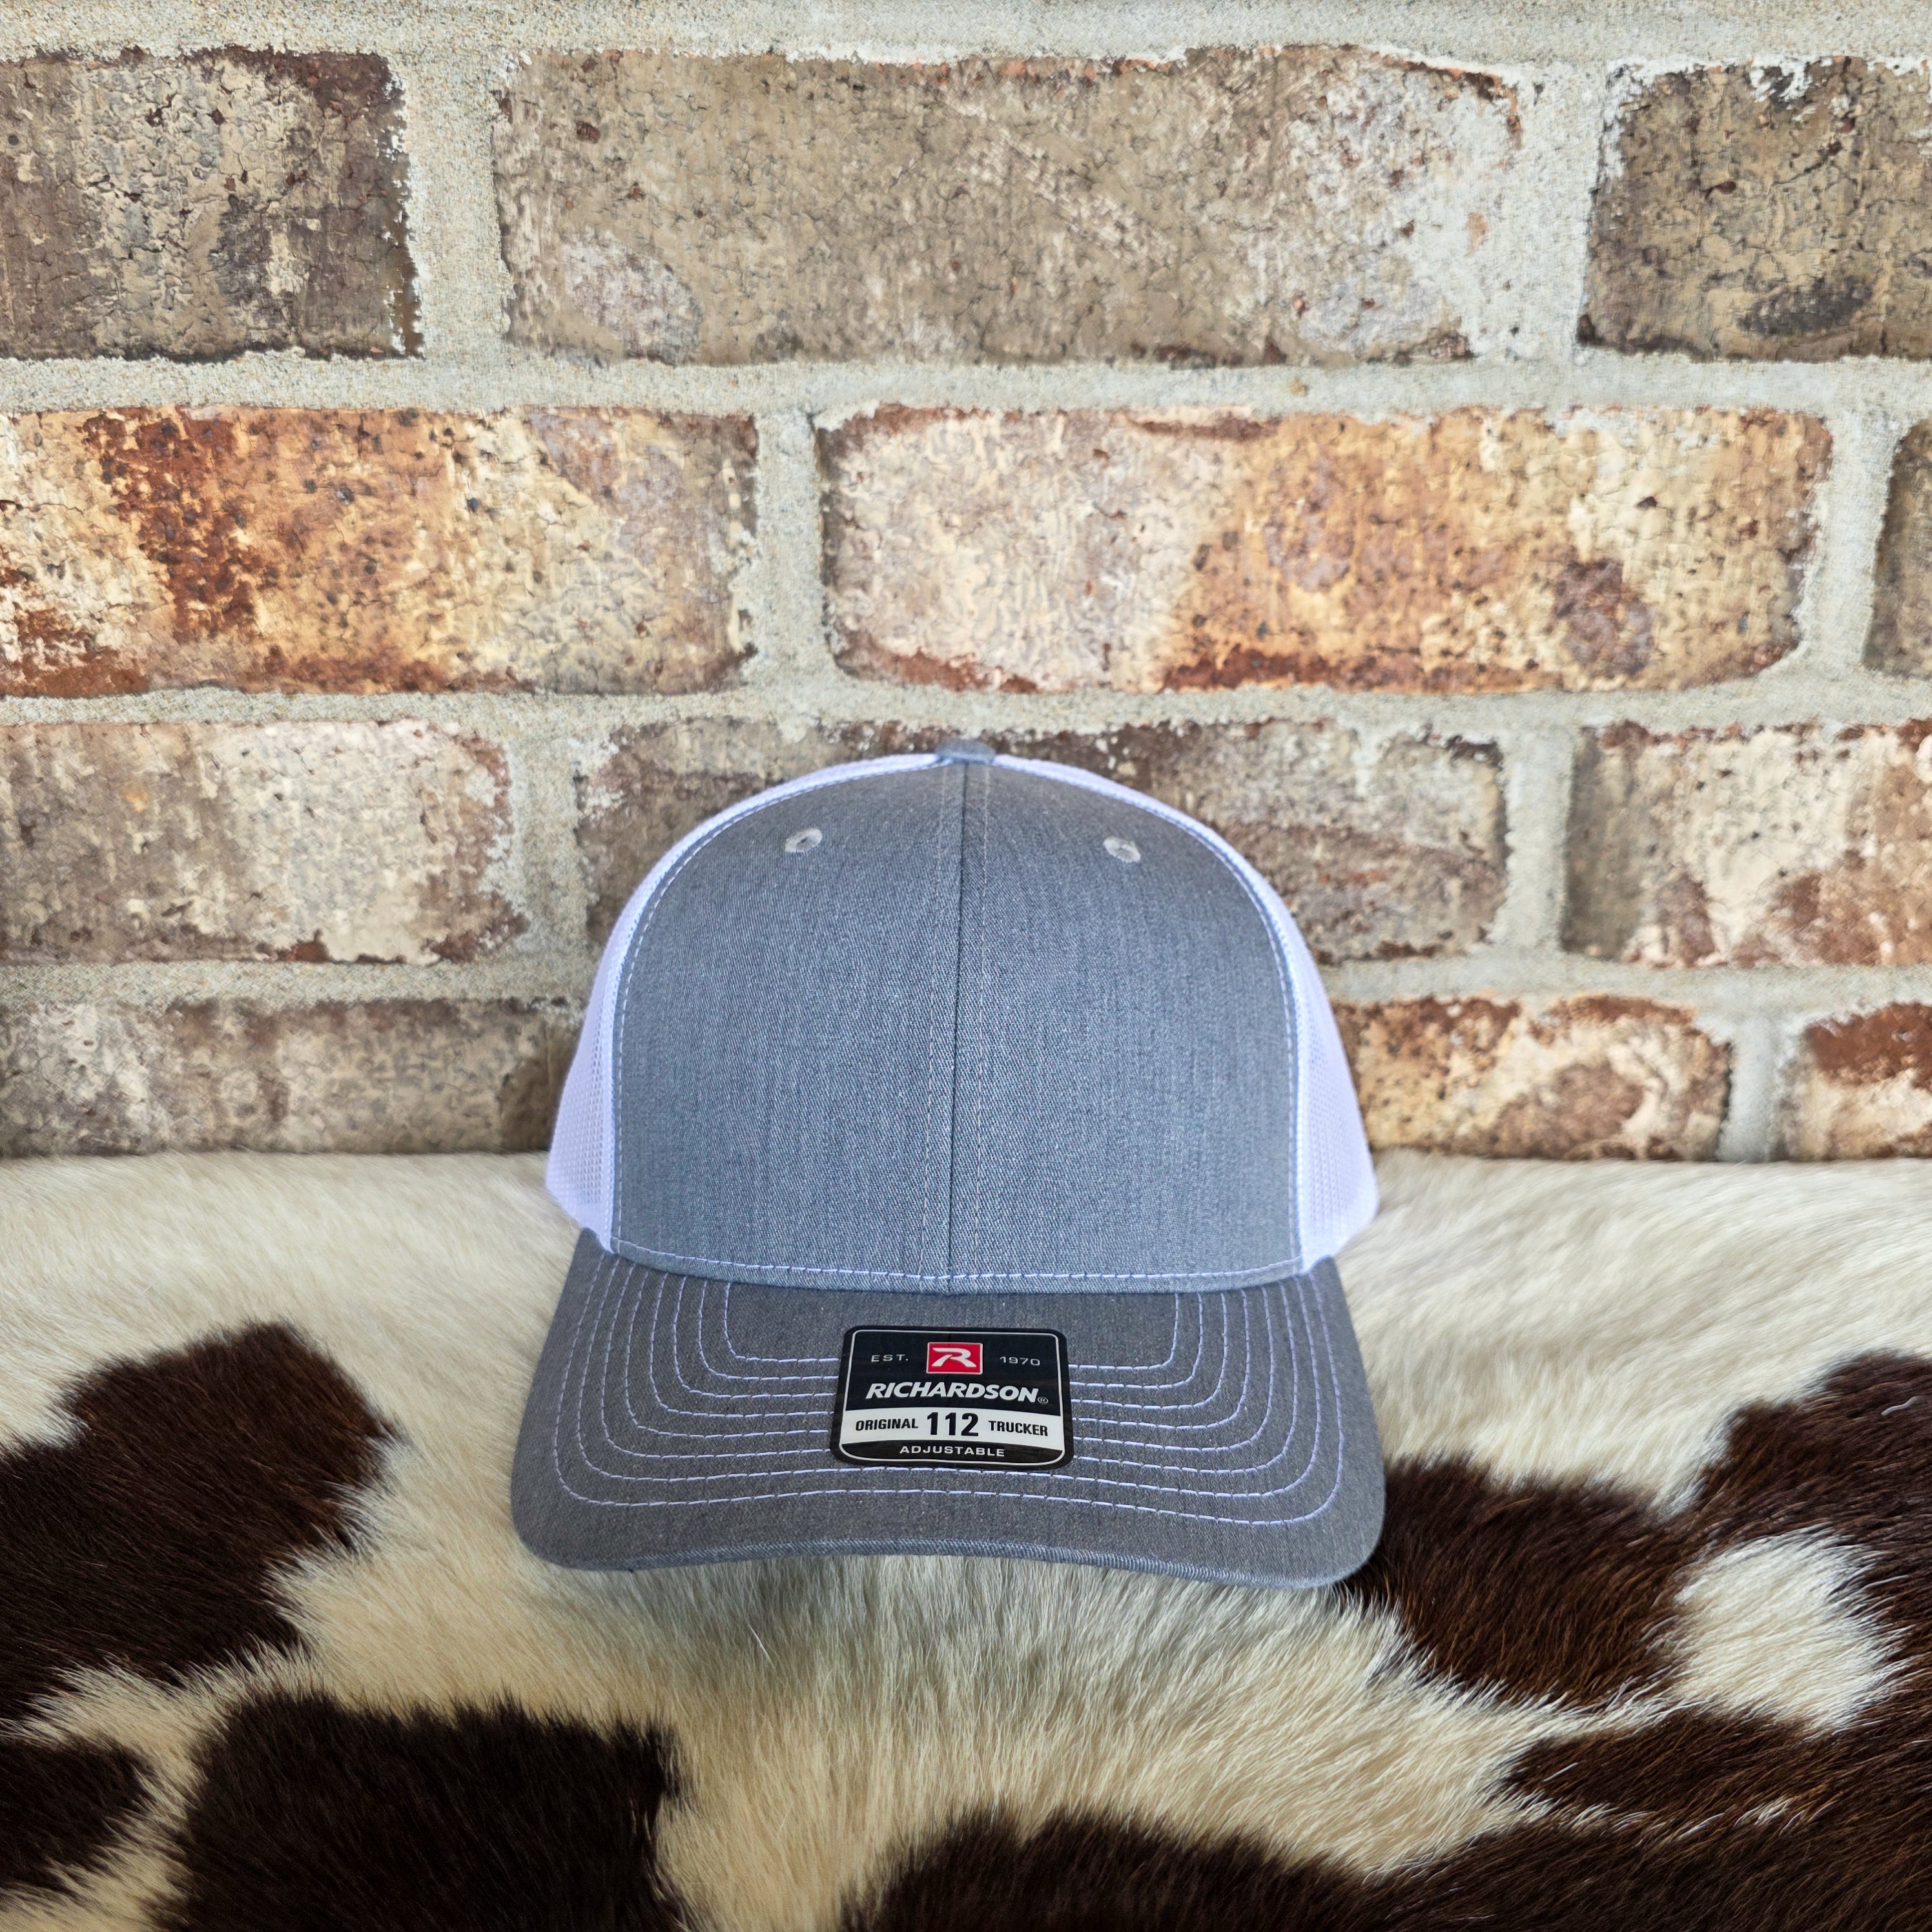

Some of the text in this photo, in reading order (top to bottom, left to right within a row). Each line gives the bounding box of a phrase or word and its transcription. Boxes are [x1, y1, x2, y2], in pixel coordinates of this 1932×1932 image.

[871, 1347, 1041, 1368] EST. R 1970
[855, 1412, 1049, 1437] ORIGINAL 112 TRUCKER
[899, 1445, 1005, 1457] ADJUSTABLE
